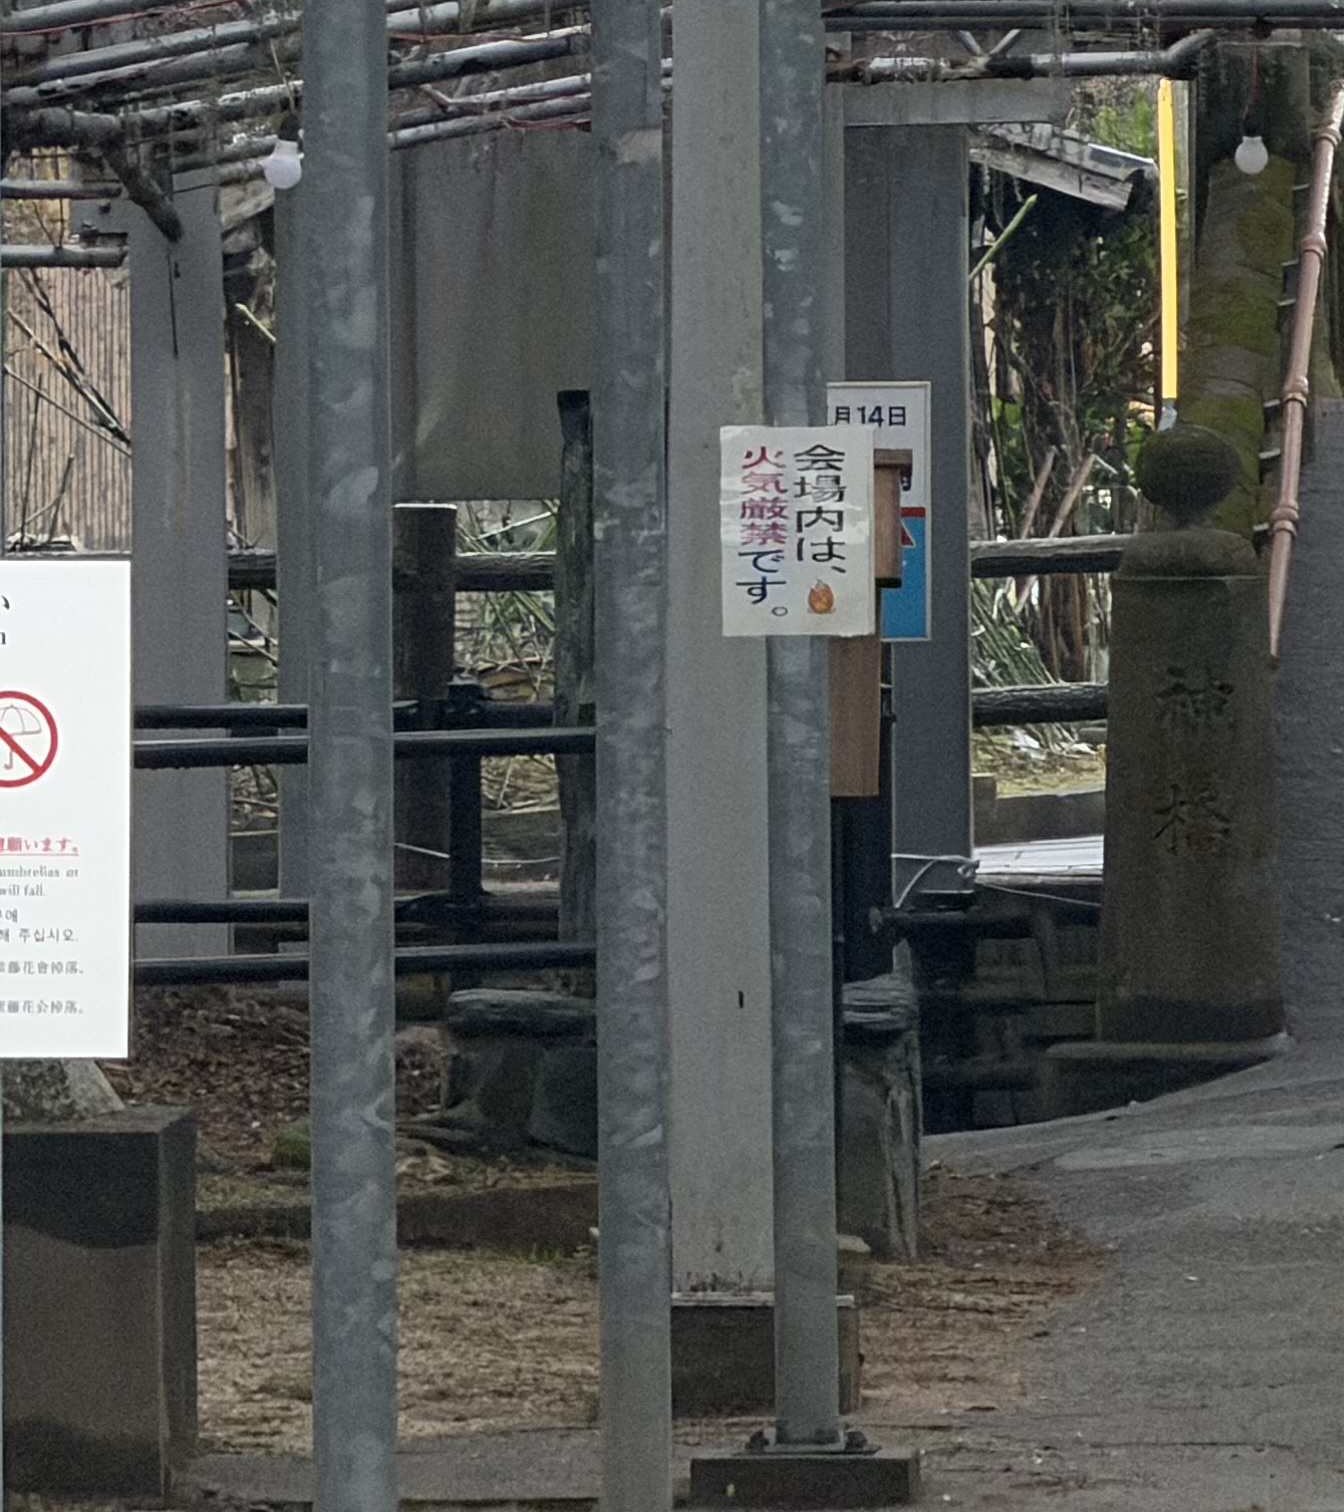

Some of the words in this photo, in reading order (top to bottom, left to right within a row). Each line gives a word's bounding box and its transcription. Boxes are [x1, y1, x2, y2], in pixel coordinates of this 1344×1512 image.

[735, 445, 789, 617] 火気厳禁です。
[793, 443, 847, 574] 会場内は、
[24, 885, 46, 897] fall.
